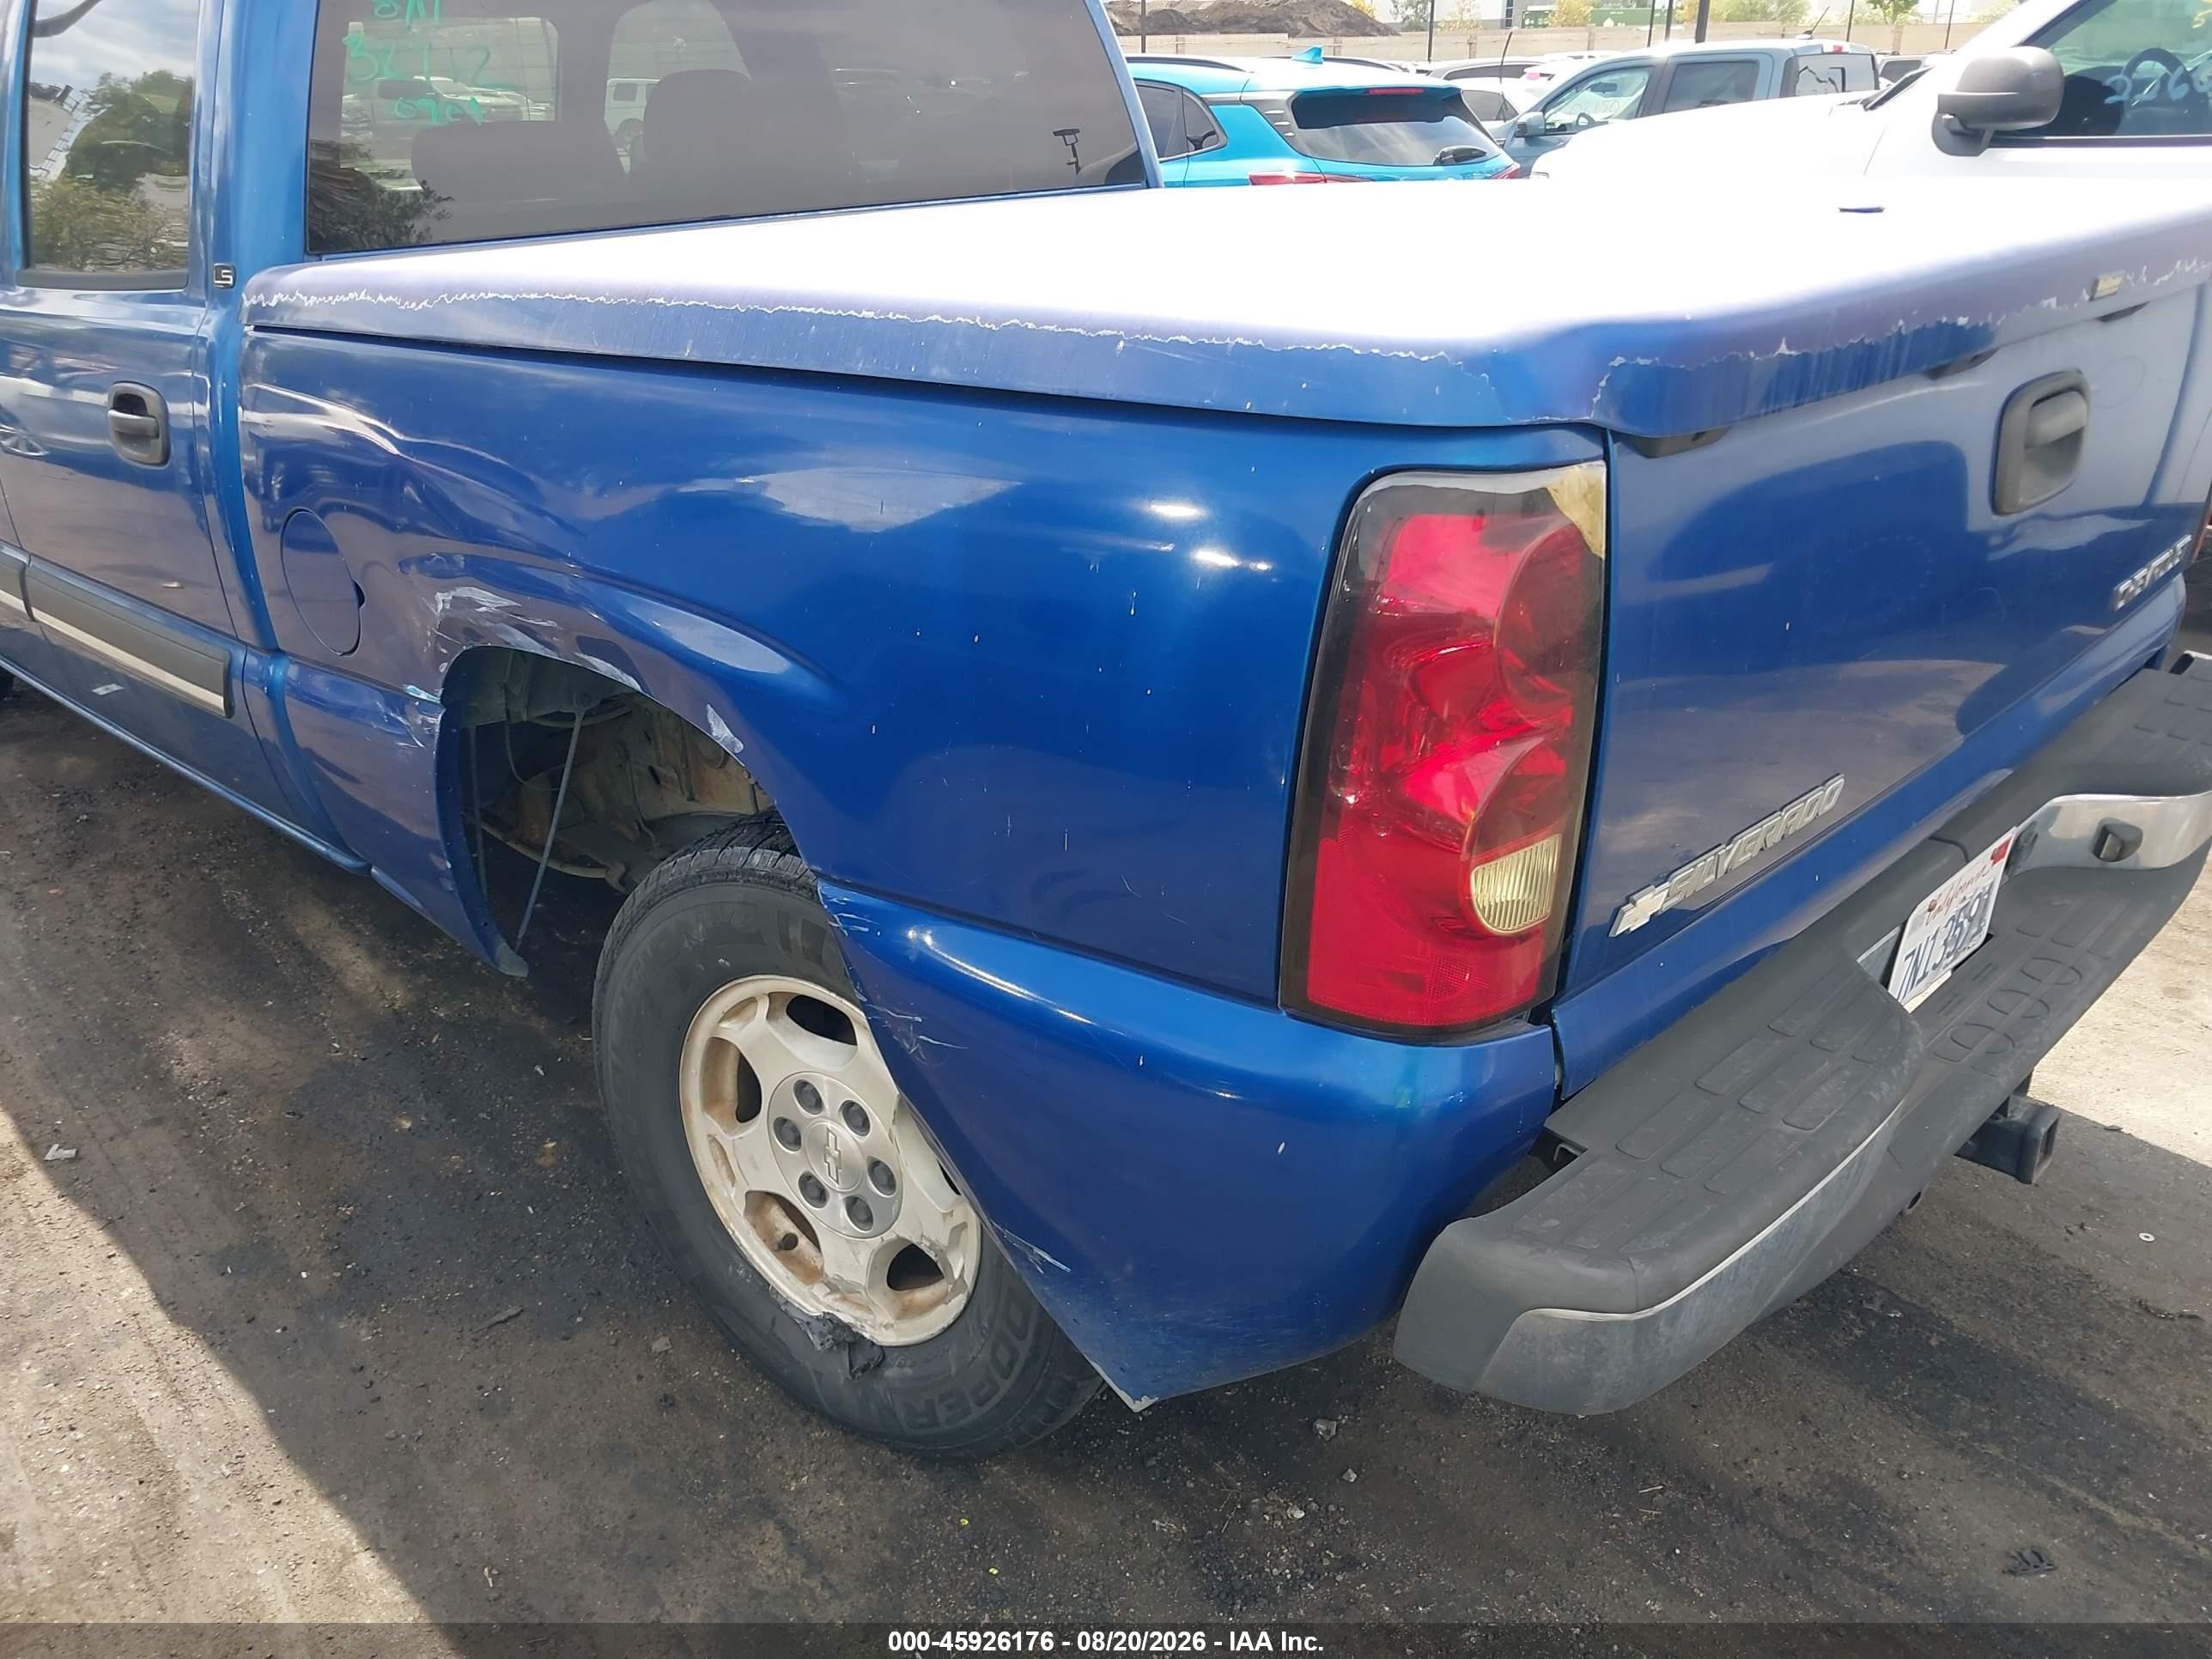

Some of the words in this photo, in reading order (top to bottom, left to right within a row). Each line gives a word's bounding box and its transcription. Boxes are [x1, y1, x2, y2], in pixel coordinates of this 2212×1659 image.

[214, 268, 234, 284] LS
[1661, 773, 1845, 914] SILVERADO
[900, 1285, 1037, 1433] OOPER
